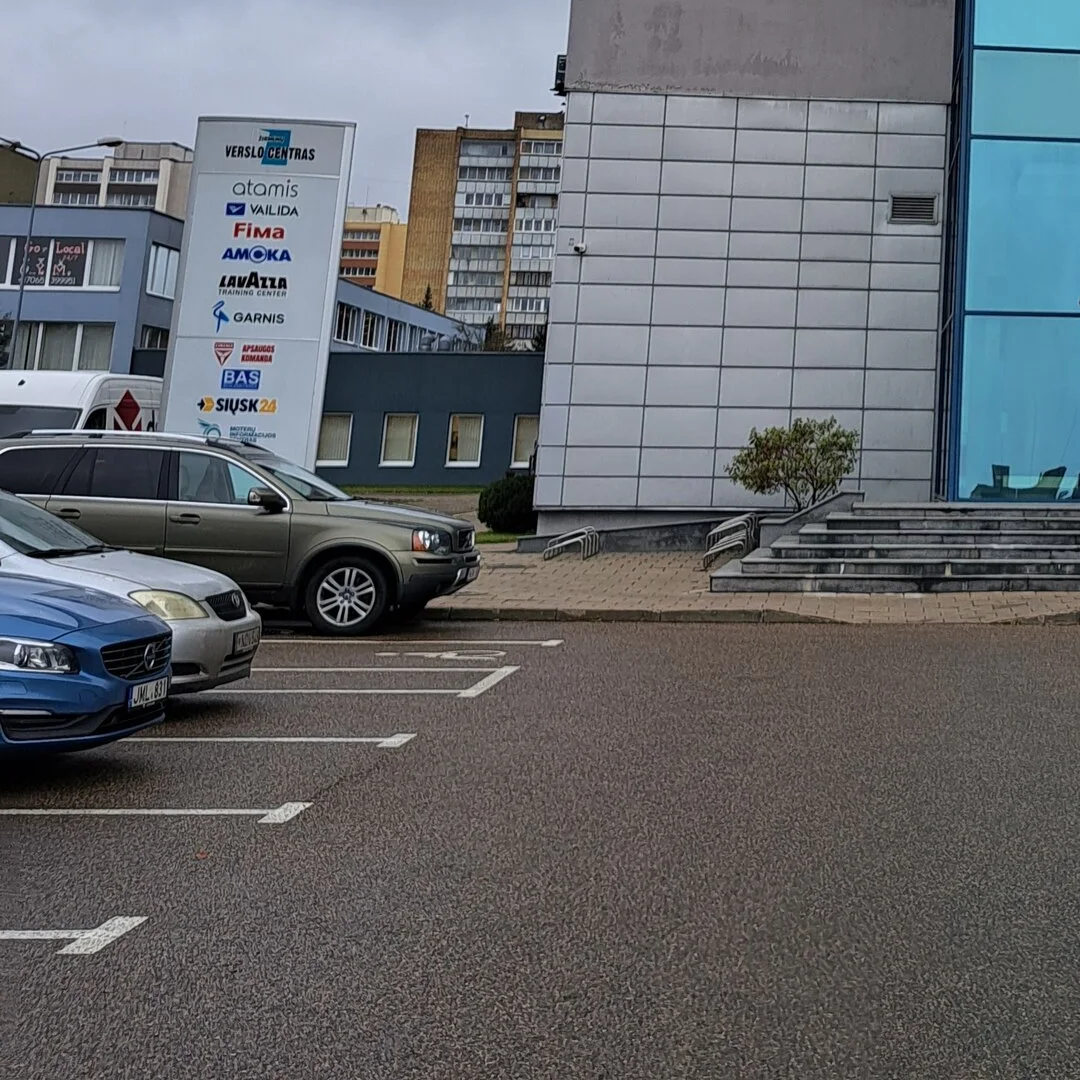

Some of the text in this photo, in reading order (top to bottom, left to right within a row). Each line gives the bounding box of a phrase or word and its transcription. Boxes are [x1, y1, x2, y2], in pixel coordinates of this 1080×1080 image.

[225, 145, 316, 161] VERSLO CENTRAS
[232, 179, 299, 198] atamis
[250, 204, 299, 217] VAILIDA
[56, 241, 85, 255] Local
[233, 312, 285, 325] GARNIS
[242, 344, 275, 353] APSAUGOS
[223, 370, 260, 384] BAS
